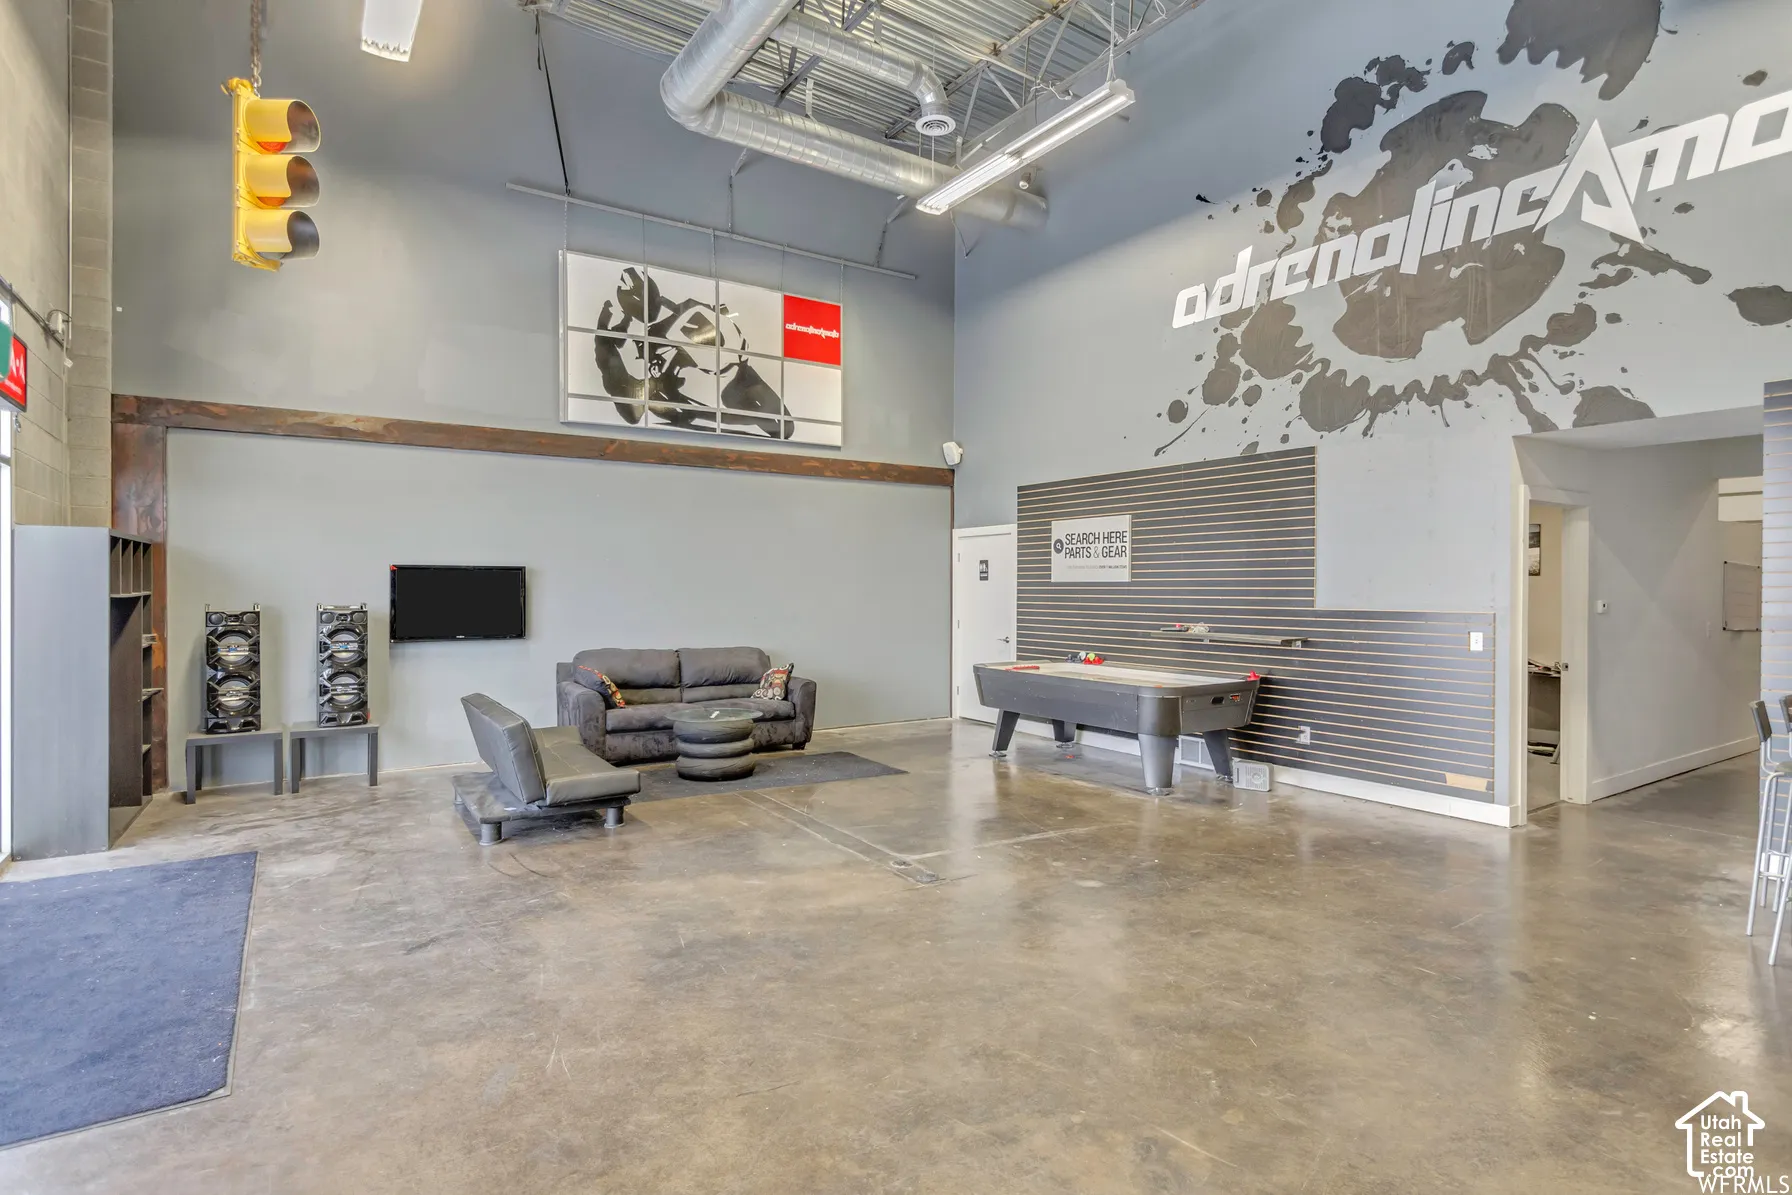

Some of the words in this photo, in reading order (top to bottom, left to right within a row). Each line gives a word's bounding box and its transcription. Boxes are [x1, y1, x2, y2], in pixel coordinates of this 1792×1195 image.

[1065, 532, 1100, 545] SEARCH
[1103, 531, 1127, 543] HERE
[1065, 547, 1091, 558] PARTS
[1093, 546, 1099, 558] &
[1102, 546, 1127, 558] GEAR
